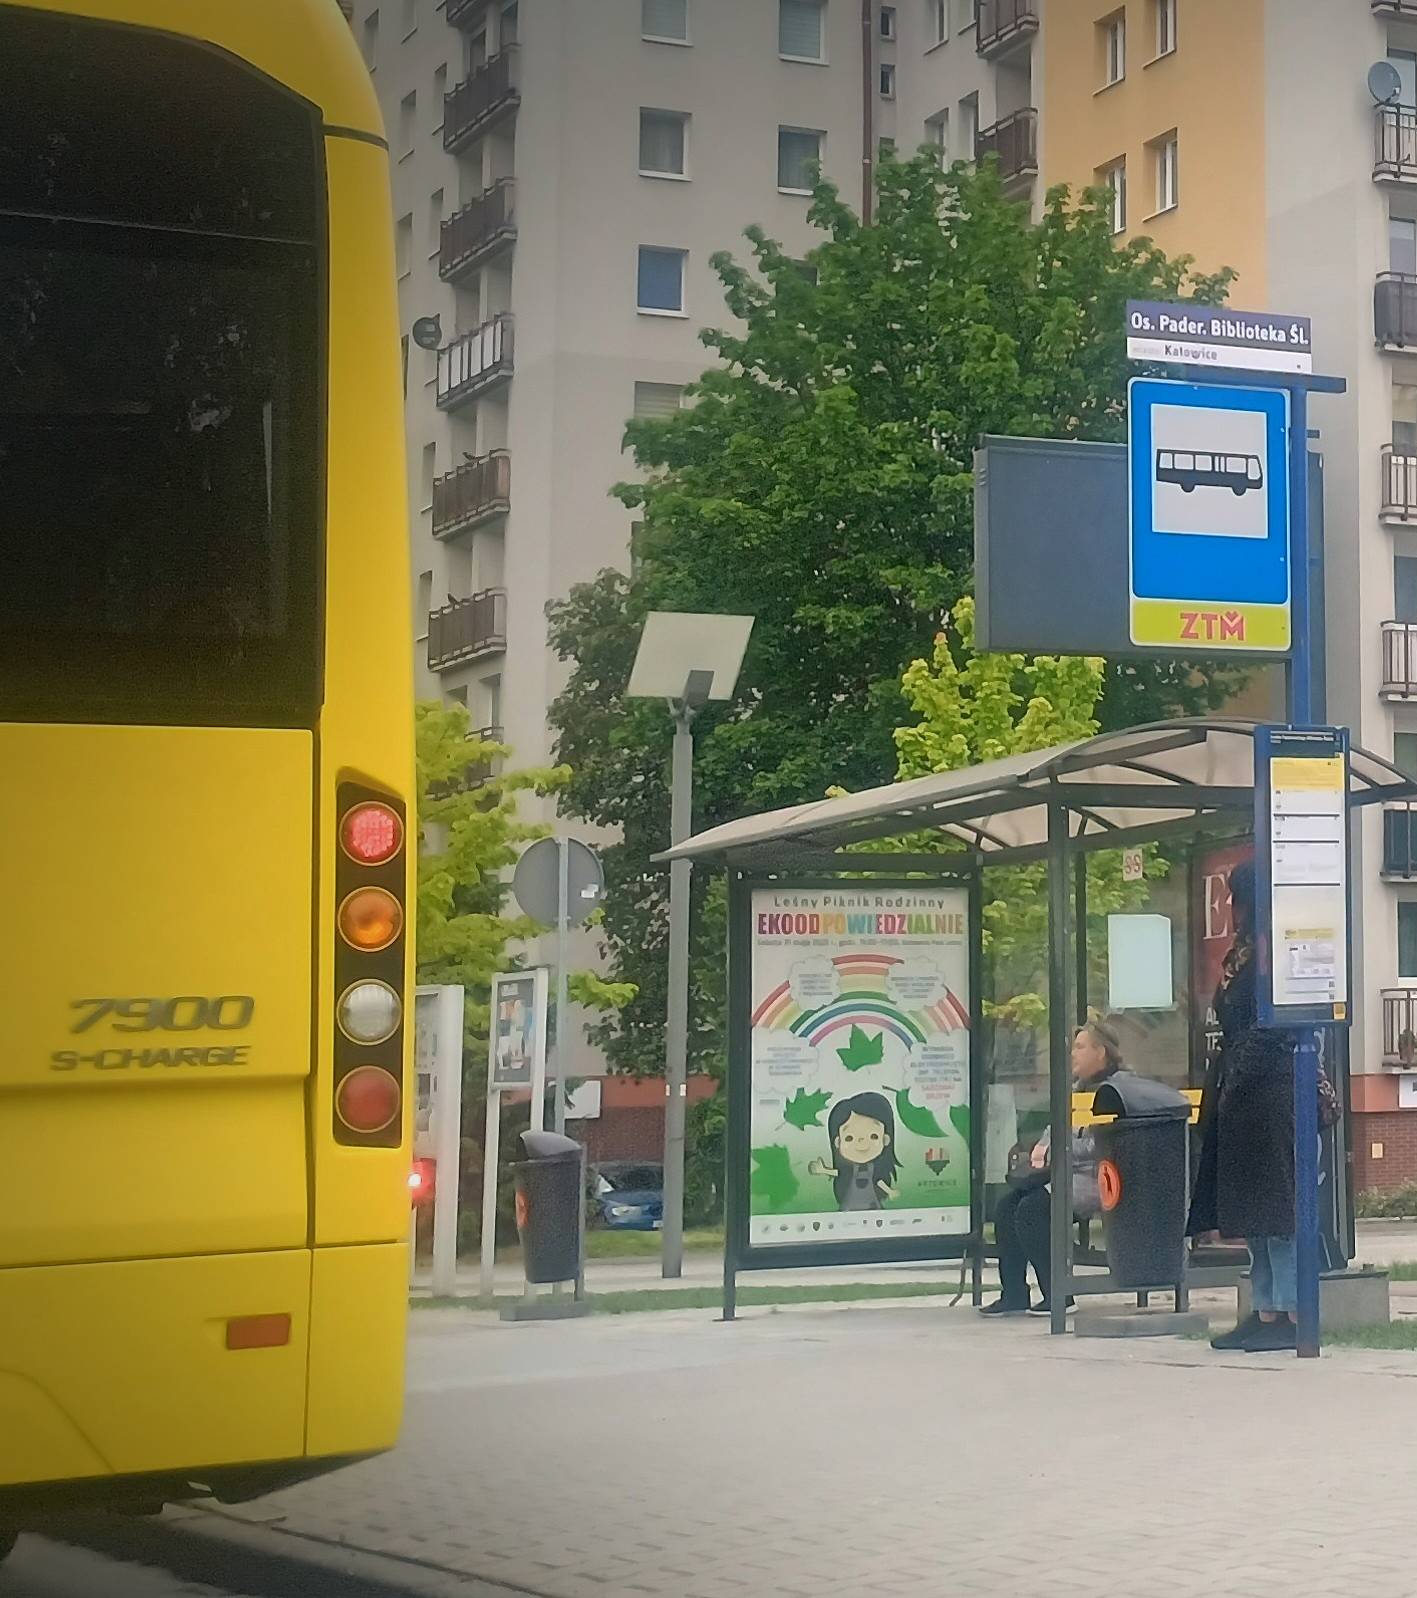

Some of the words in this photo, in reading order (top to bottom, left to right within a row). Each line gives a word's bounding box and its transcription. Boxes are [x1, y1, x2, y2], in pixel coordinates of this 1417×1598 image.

[1131, 312, 1155, 331] Os.
[1159, 315, 1207, 336] Pader.
[1211, 319, 1287, 343] Biblioteka
[1289, 323, 1309, 345] Śl.
[1164, 344, 1218, 361] Katowice
[1180, 611, 1245, 641] ZTM
[774, 896, 818, 908] Leśny
[823, 896, 870, 907] Piknik
[875, 896, 945, 909] Rodzinny
[758, 913, 963, 935] EKOODPOWIEDZIALNIE
[70, 996, 255, 1034] 7900
[50, 1045, 251, 1071] S-CHARGE
